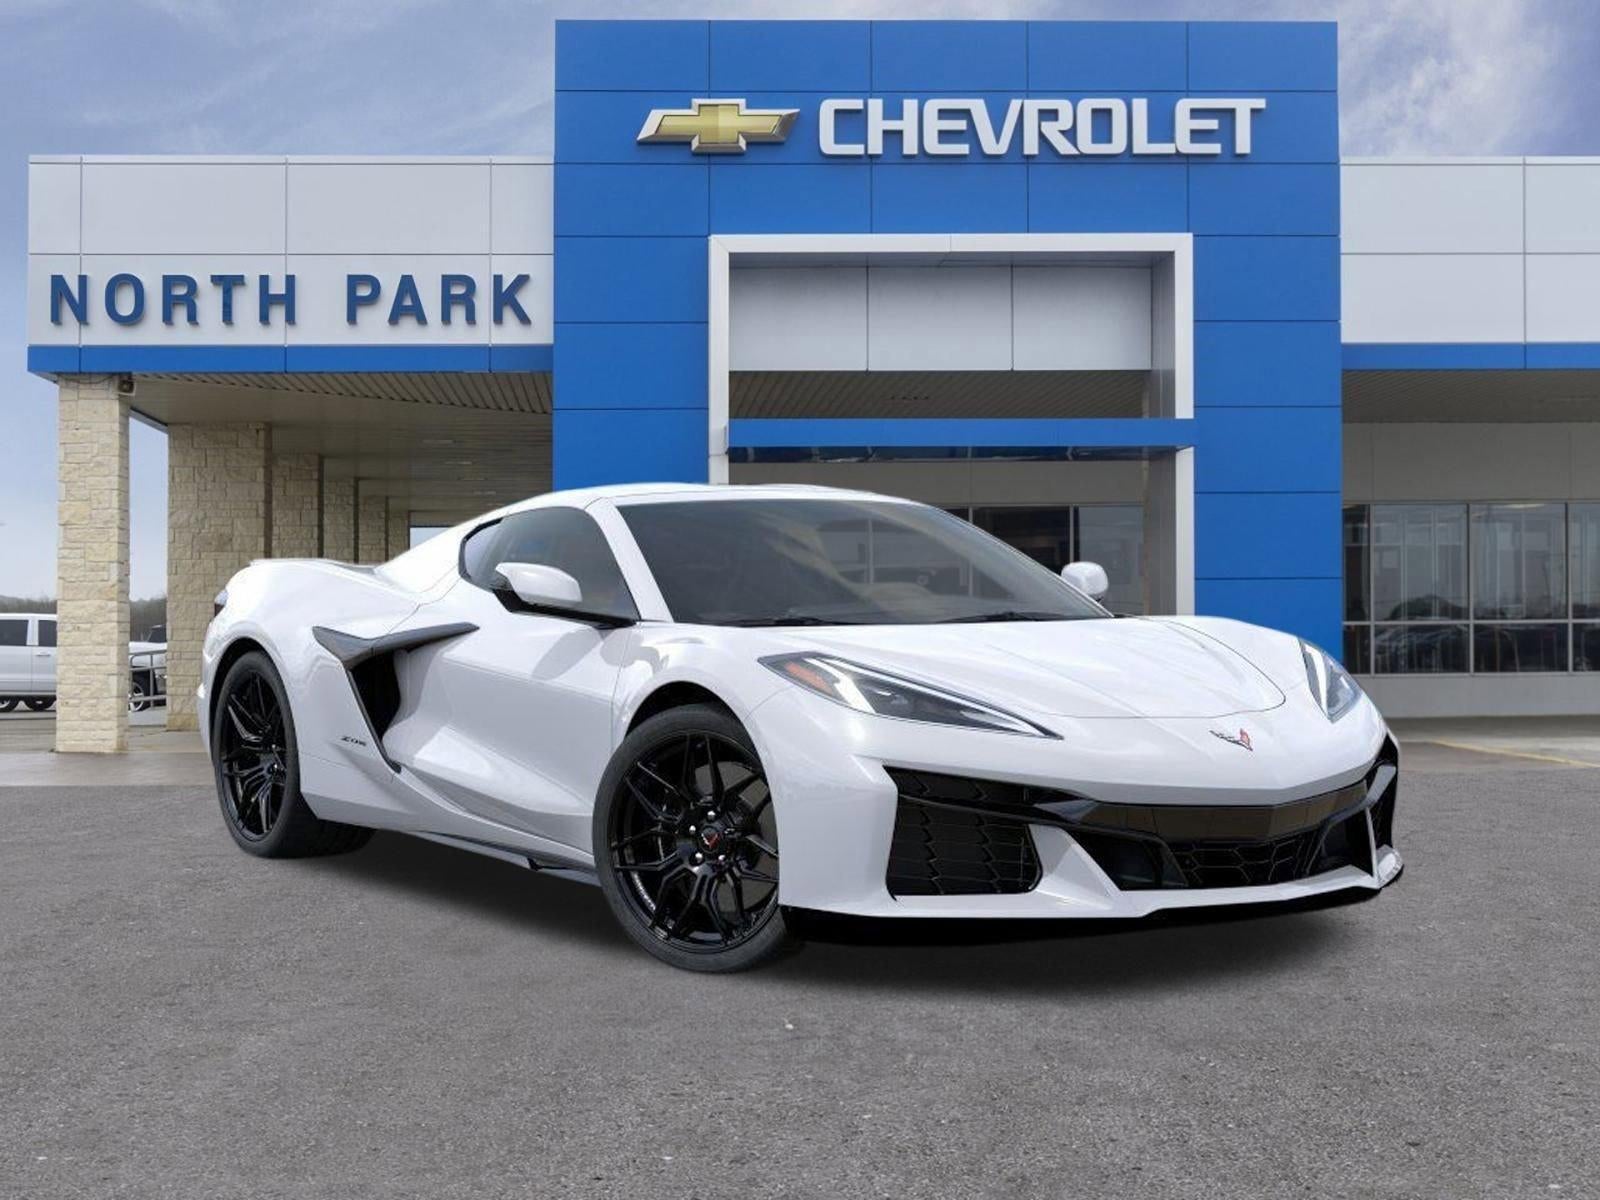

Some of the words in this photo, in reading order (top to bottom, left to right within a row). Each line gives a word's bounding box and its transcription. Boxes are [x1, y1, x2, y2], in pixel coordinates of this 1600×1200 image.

[819, 98, 1266, 155] CHEVROLET
[50, 273, 296, 325] NORTH
[347, 274, 532, 326] PARK
